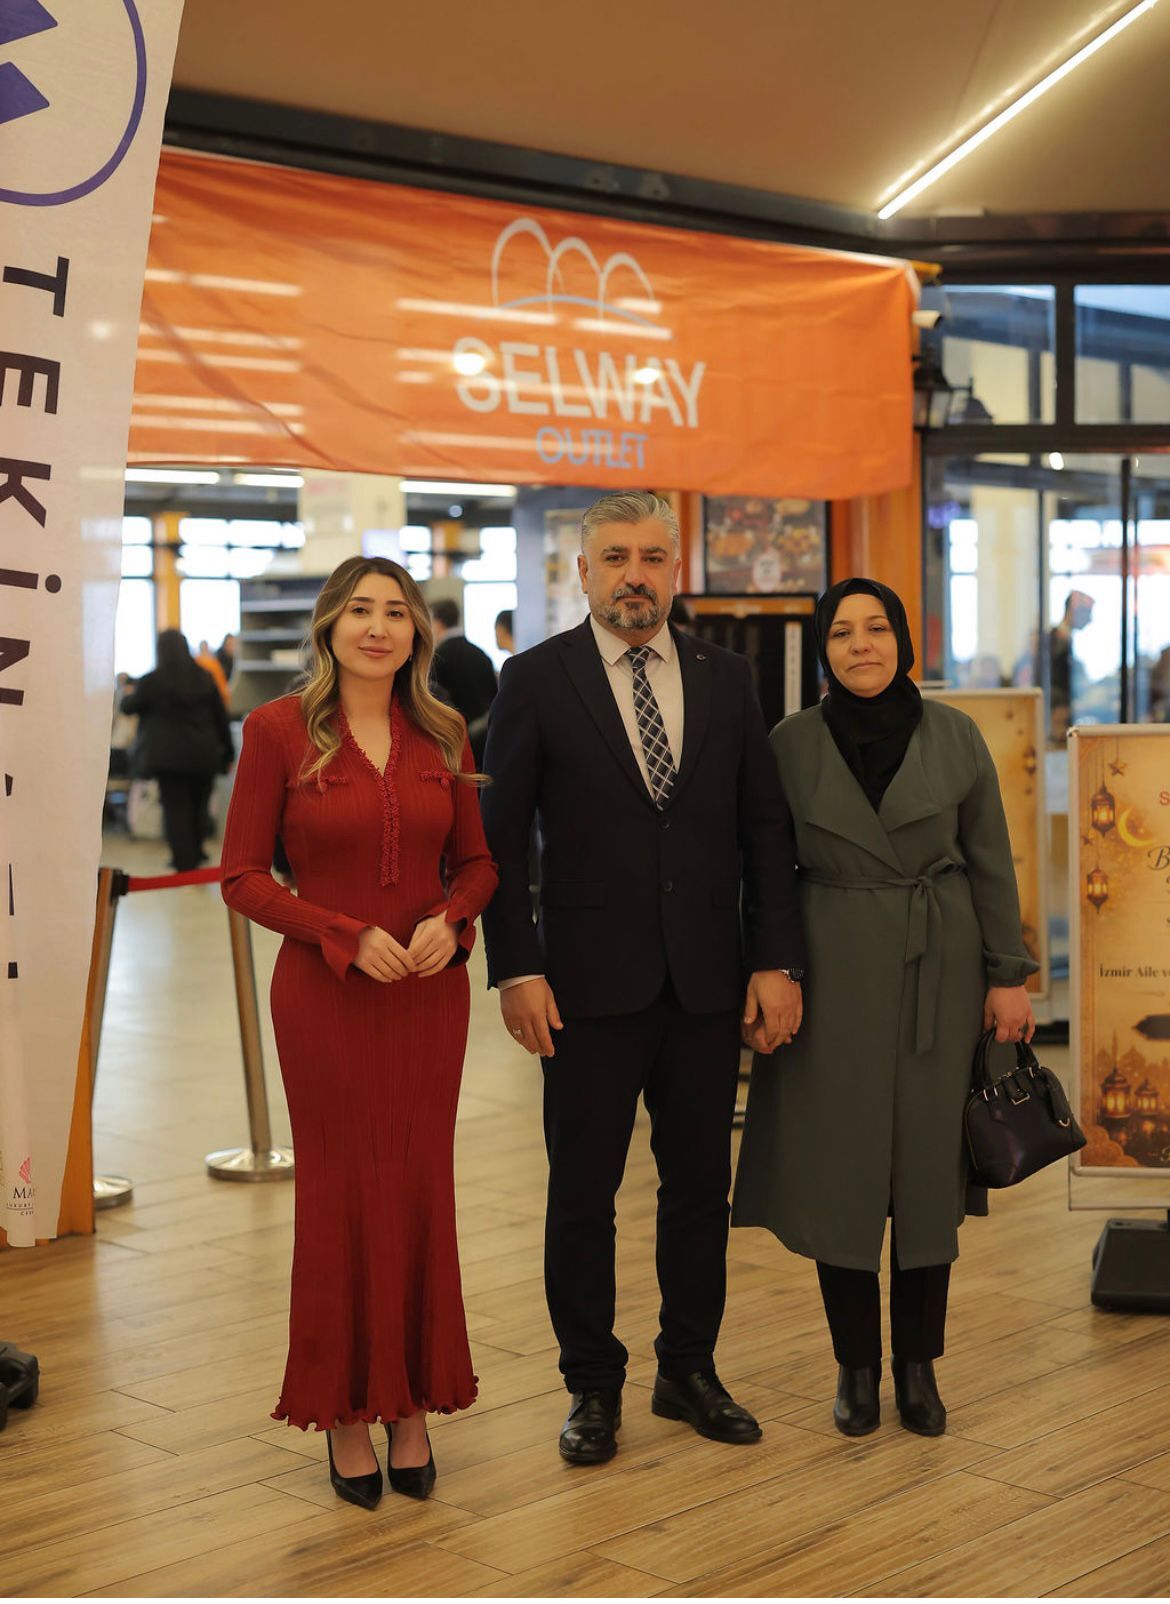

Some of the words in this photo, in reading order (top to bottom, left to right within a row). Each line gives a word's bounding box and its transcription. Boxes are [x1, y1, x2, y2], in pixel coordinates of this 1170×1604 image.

[453, 336, 706, 428] SELWAY
[535, 426, 648, 469] OUTLET
[1099, 963, 1133, 978] İzmir
